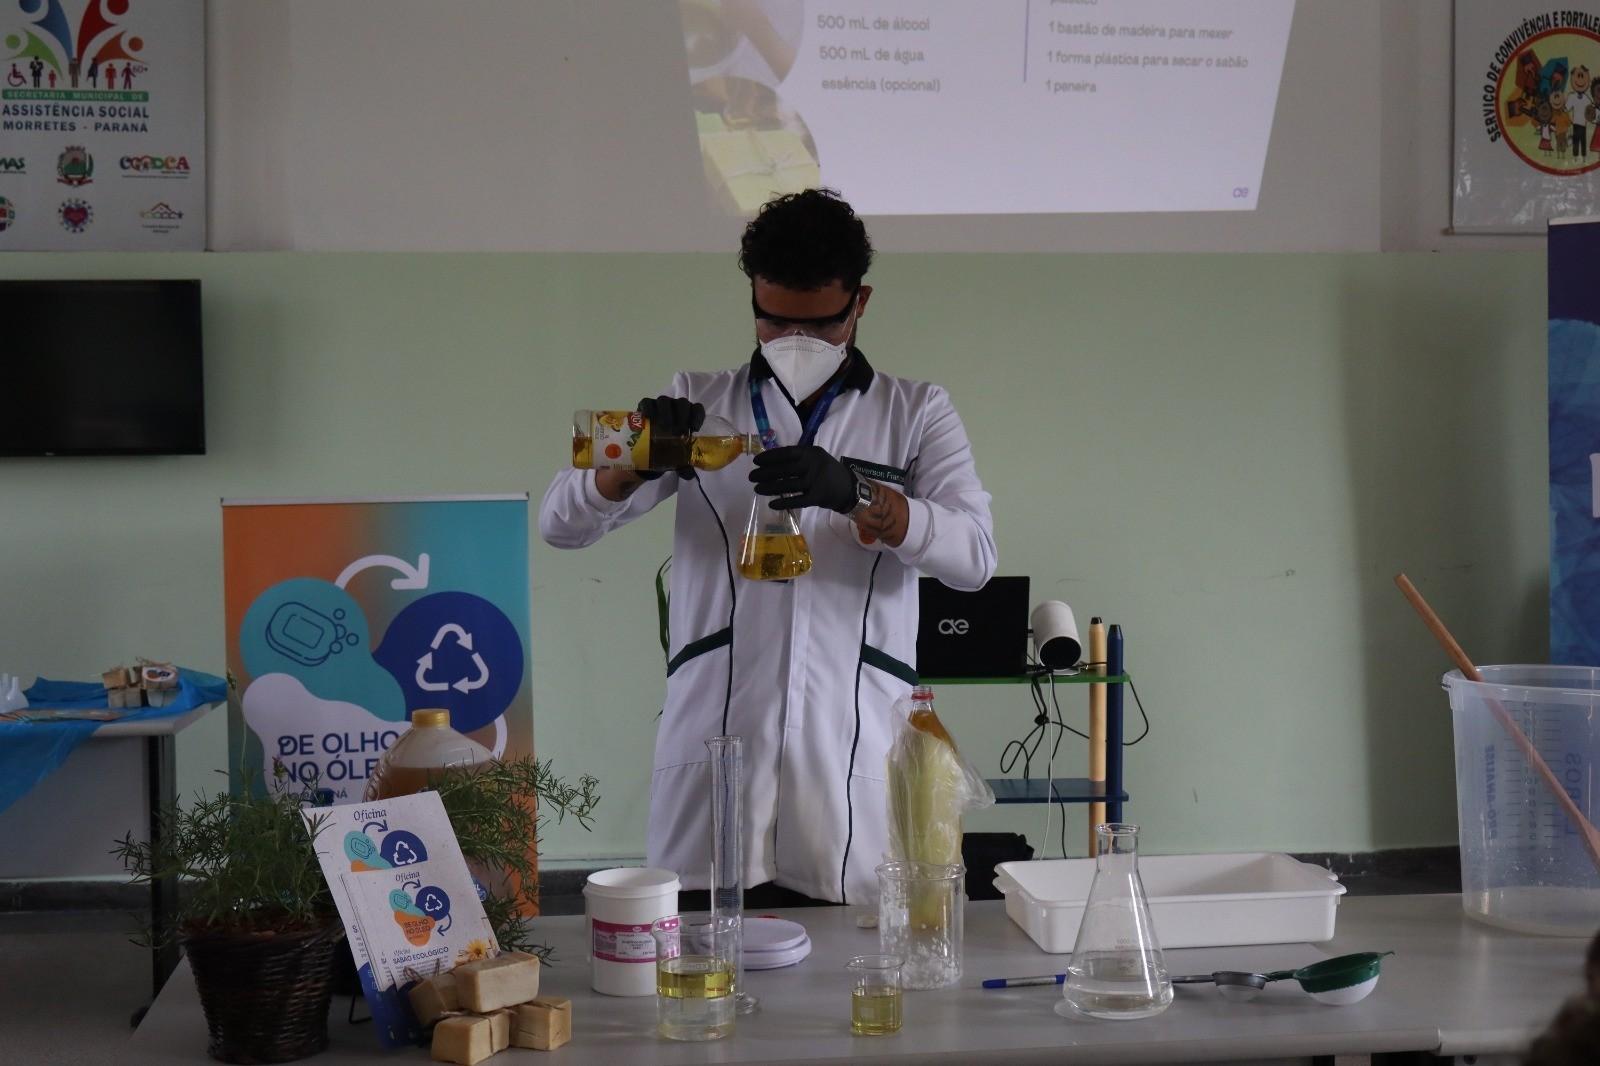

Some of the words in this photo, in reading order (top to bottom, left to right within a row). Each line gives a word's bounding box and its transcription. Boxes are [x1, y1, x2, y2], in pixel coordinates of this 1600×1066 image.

[817, 15, 845, 30] 500
[849, 16, 870, 31] mL
[872, 16, 889, 31] de
[893, 16, 930, 31] álcool
[1048, 21, 1054, 33] 1
[1057, 21, 1099, 36] bastão
[1101, 23, 1116, 37] de
[1119, 24, 1166, 38] madeira
[1168, 27, 1195, 41] para
[1198, 28, 1233, 40] mexer
[819, 45, 847, 60] 500
[851, 47, 871, 61] mL
[874, 48, 890, 62] de
[894, 48, 925, 65] água
[1486, 62, 1501, 82] DE
[1553, 11, 1559, 27] E
[1047, 51, 1053, 63] 1
[1055, 51, 1091, 64] forma
[1094, 52, 1139, 69] plástica
[1142, 55, 1169, 70] para
[1171, 55, 1203, 67] secar
[1205, 59, 1213, 67] o
[1215, 56, 1249, 69] sabão
[821, 76, 877, 91] essência
[880, 78, 941, 94] (opcional)
[1046, 80, 1051, 92] 1
[1054, 81, 1096, 94] peneira
[7, 91, 66, 100] SECRETARIA
[72, 92, 124, 101] MUNICIPAL
[132, 92, 144, 101] DE
[2, 103, 95, 118] ASSISTÊNCIA
[98, 105, 150, 119] SOCIAL
[3, 121, 77, 132] MORRETES
[94, 121, 148, 133] PARANÁ
[277, 734, 315, 757] DE
[322, 730, 399, 754] OLHO
[327, 754, 379, 781] ÓLE
[353, 808, 387, 823] Oficina
[395, 869, 421, 883] Oficina
